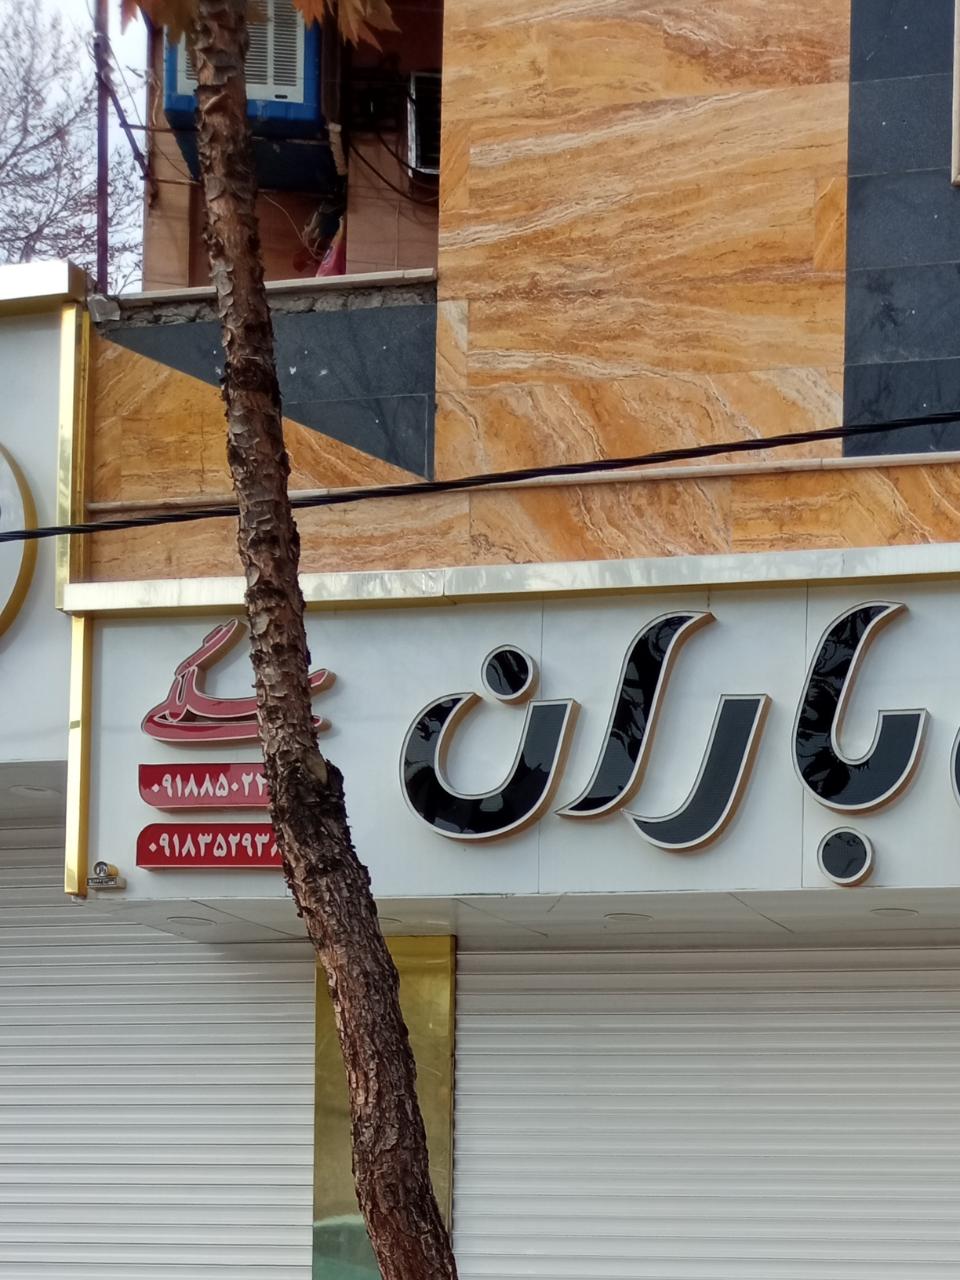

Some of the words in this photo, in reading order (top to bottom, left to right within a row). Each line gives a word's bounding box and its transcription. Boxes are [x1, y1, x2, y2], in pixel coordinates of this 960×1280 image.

[399, 600, 930, 887] باران
[151, 771, 269, 798] ۰۹۱۸۸۵۰۲
[148, 832, 282, 858] ۰۹۱۸۳۵۲۹۳
